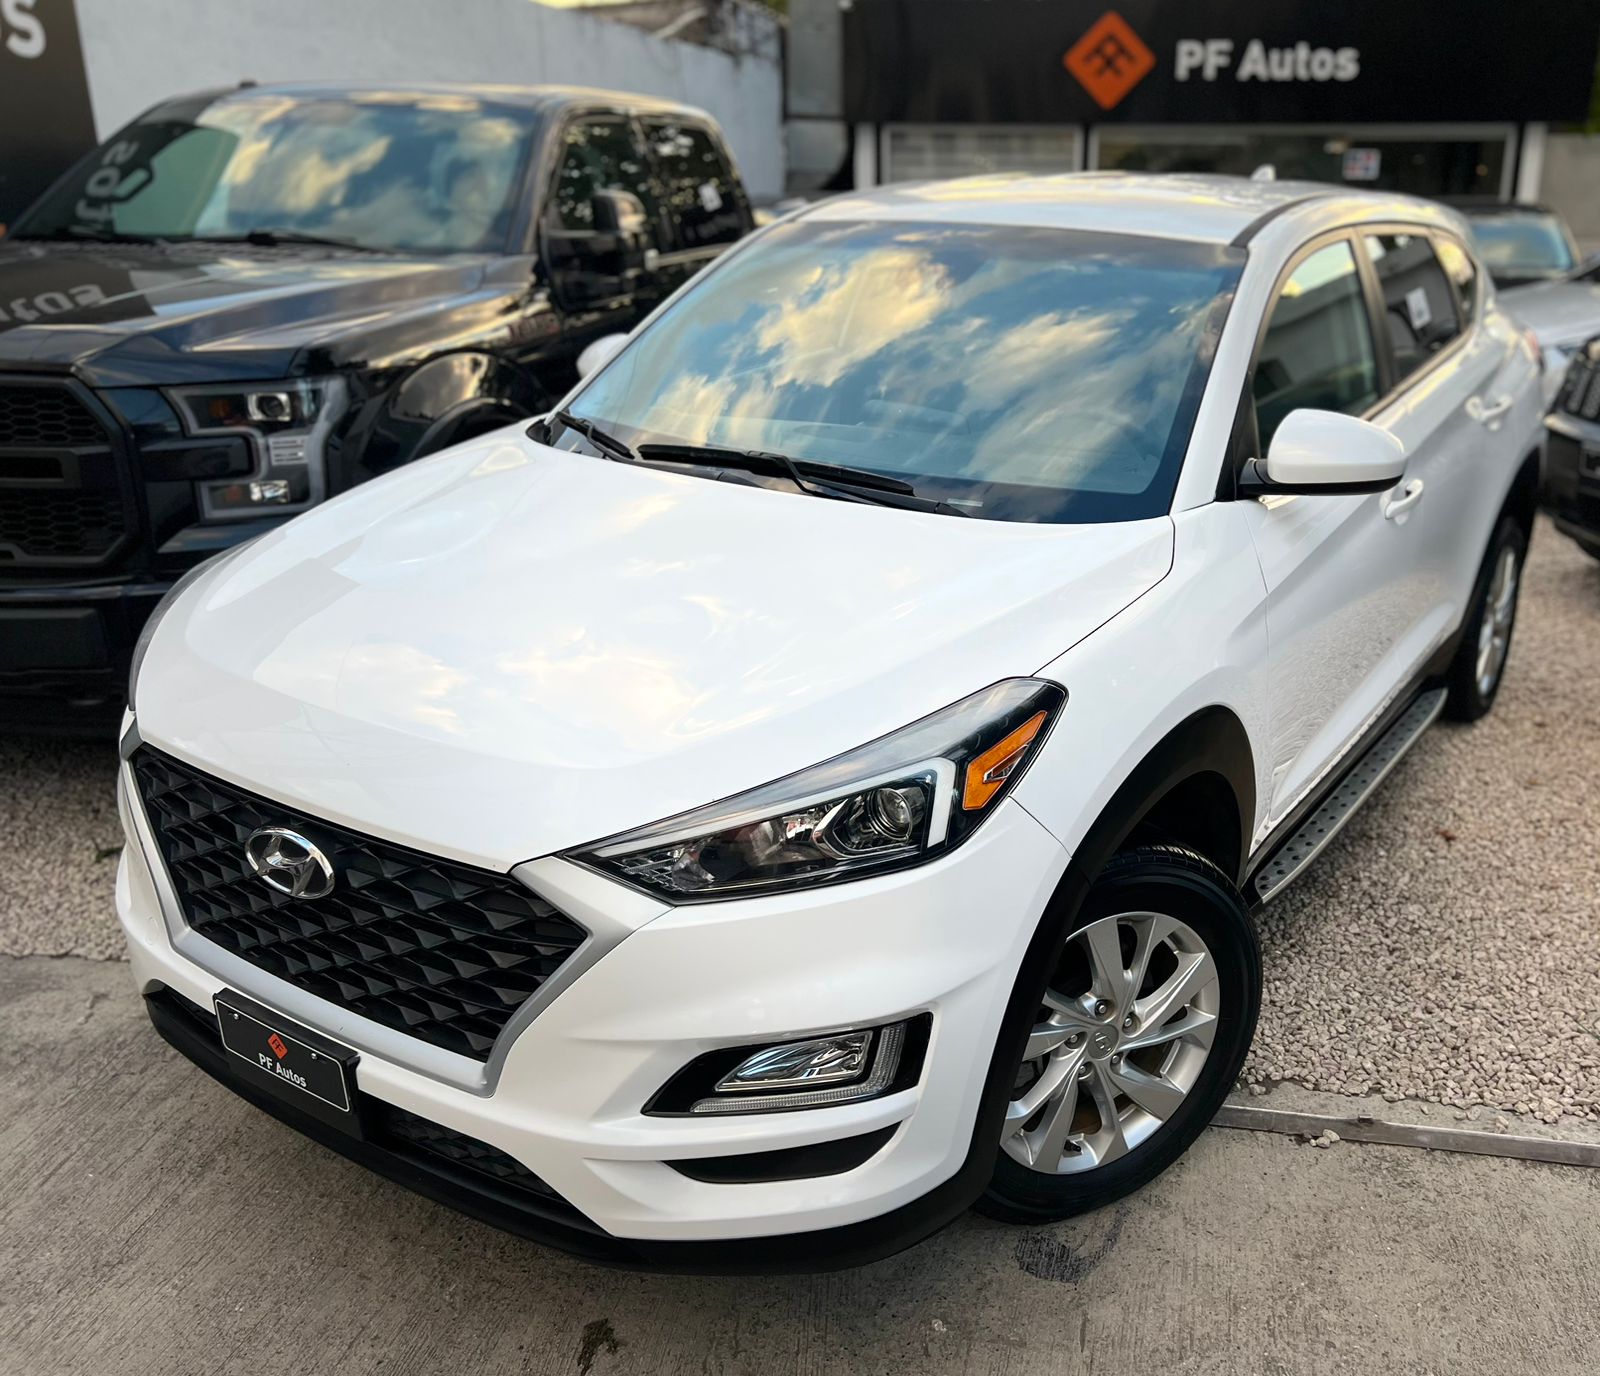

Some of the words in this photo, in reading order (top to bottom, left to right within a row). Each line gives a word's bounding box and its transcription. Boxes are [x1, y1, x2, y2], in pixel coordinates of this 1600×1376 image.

[1174, 38, 1234, 82] PF
[1236, 38, 1360, 82] Autos
[259, 1052, 273, 1069] PF
[276, 1061, 307, 1087] Autos
